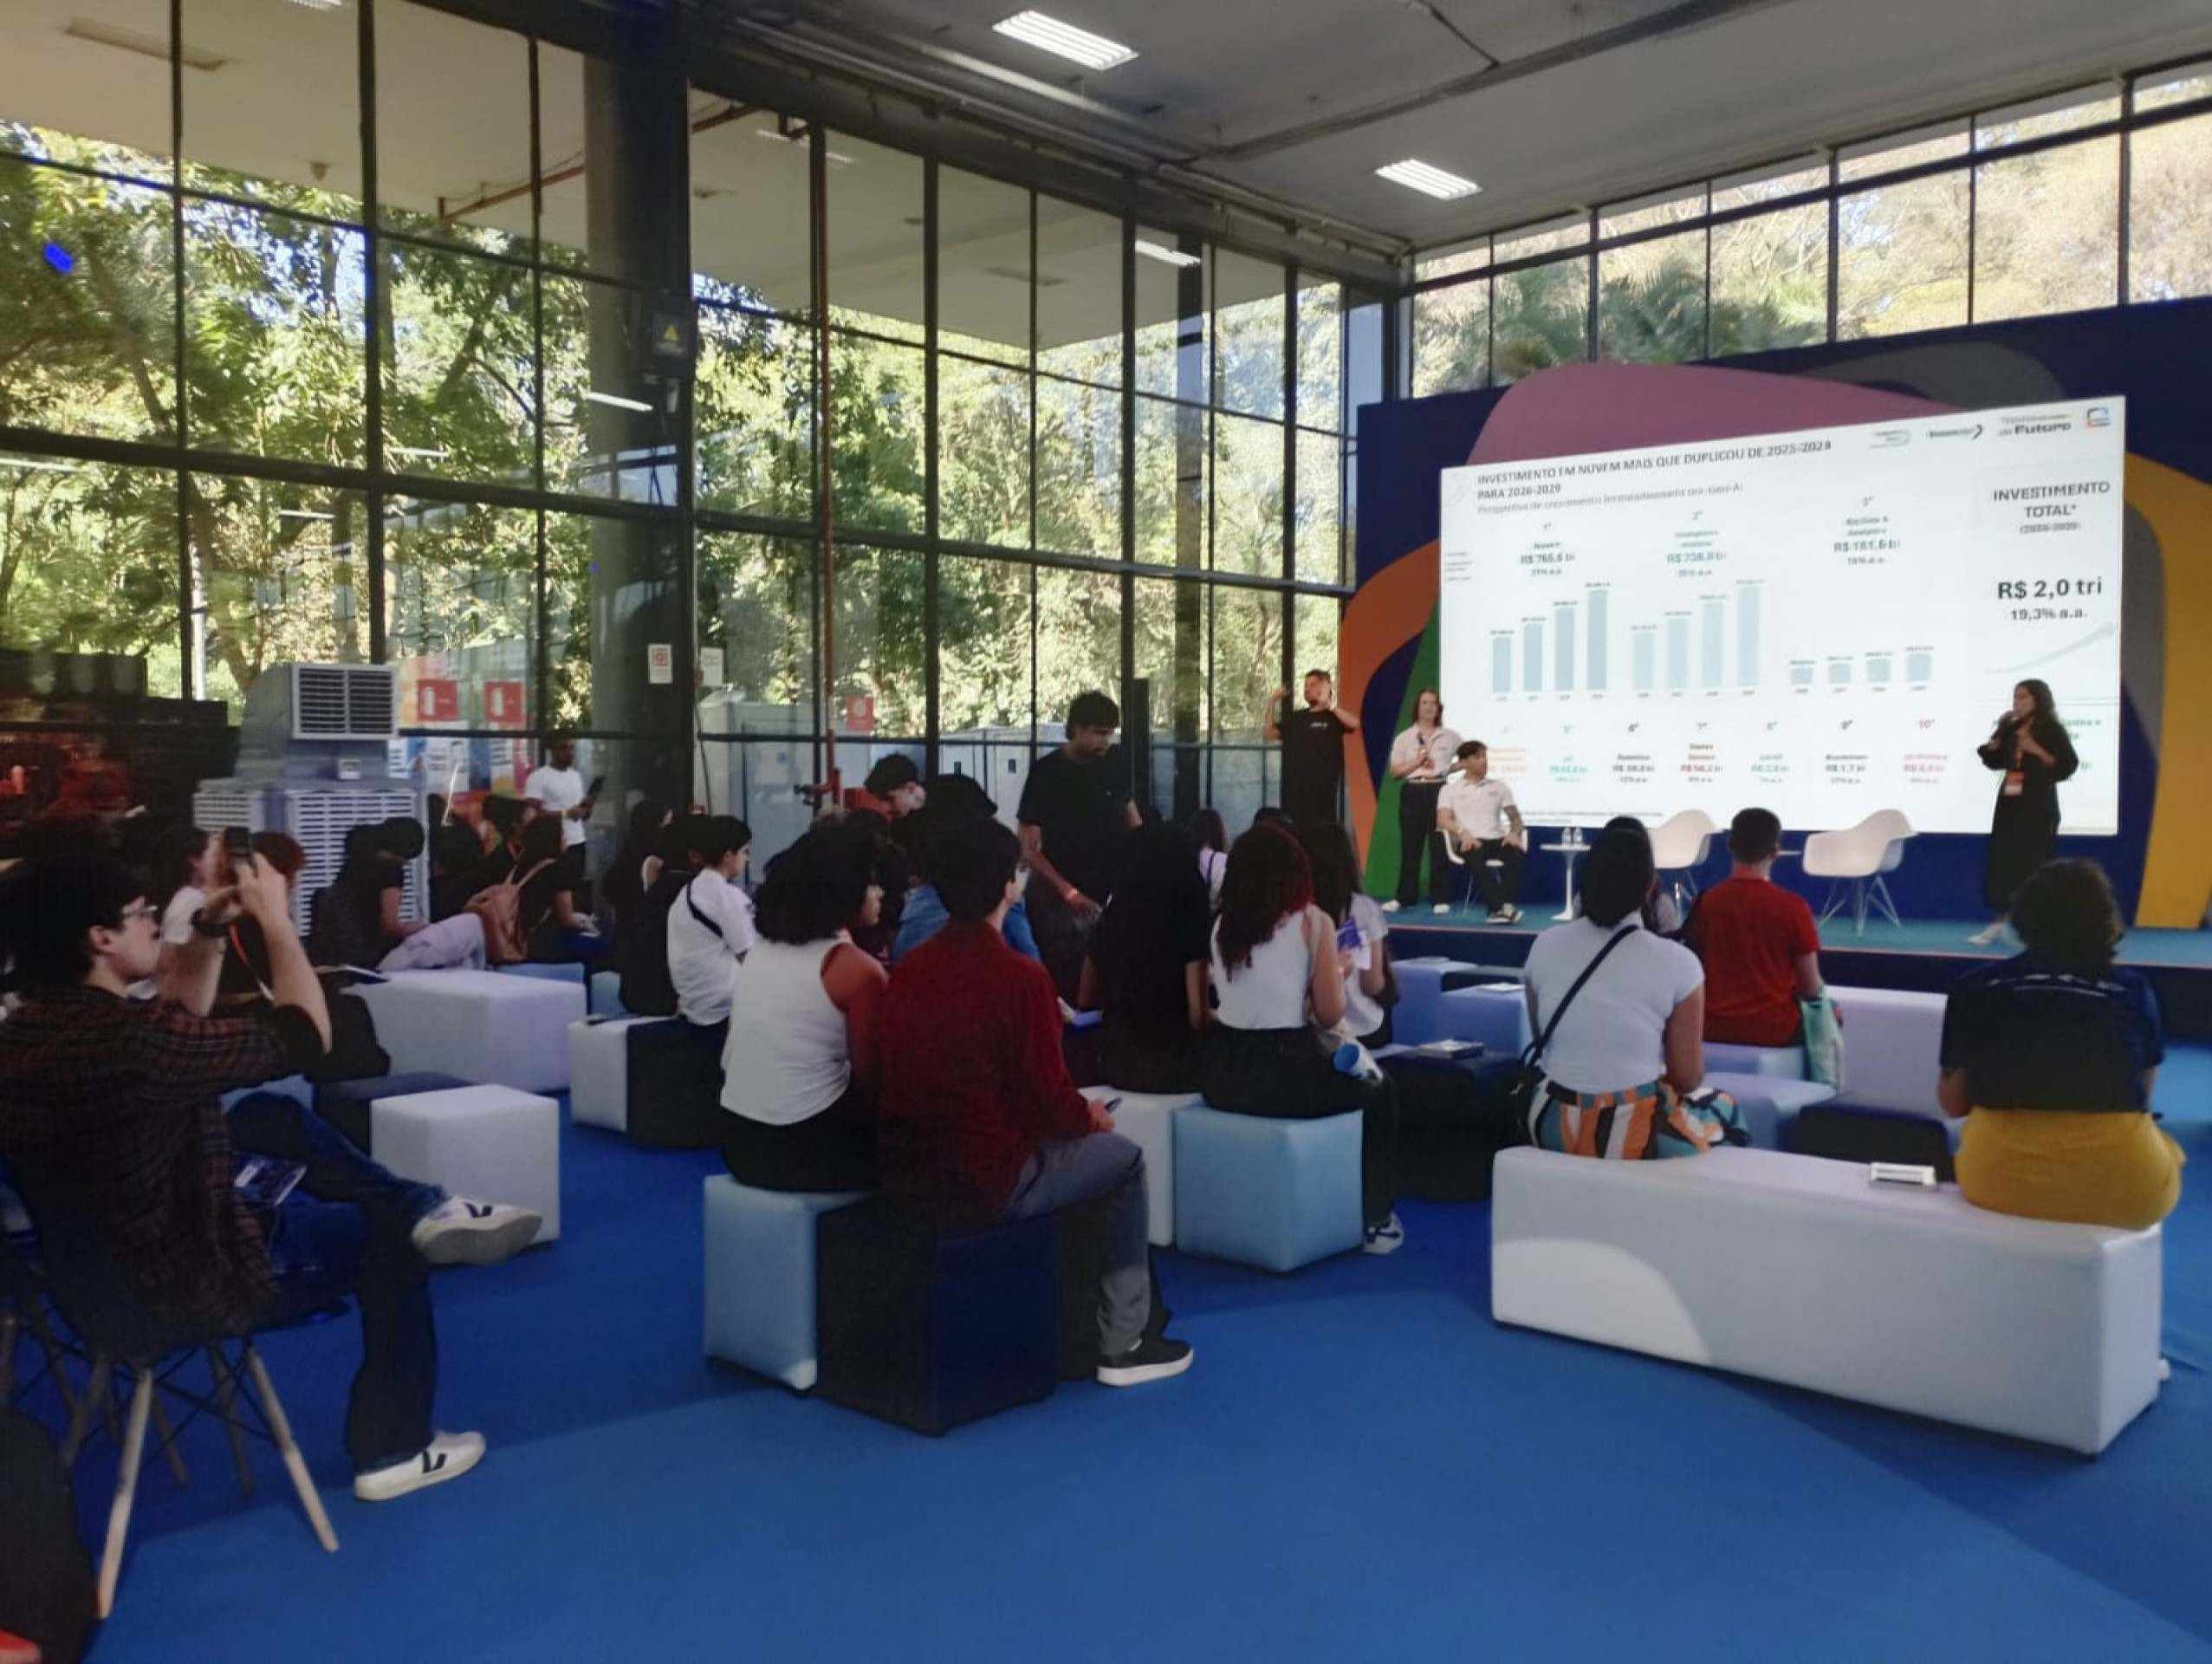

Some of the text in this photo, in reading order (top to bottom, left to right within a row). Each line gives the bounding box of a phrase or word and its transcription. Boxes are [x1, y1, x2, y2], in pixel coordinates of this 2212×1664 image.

[1477, 467, 1556, 485] INVESTIMENTO
[1558, 465, 1577, 478] EM
[1577, 461, 1621, 477] NUVEM
[1623, 457, 1654, 471] MAIS
[1655, 453, 1681, 469] QUE
[1683, 447, 1745, 466] DUPLICOU
[1747, 445, 1766, 459] DE
[1476, 486, 1506, 501] PARA
[1993, 481, 2111, 501] INVESTIMENTO
[1997, 575, 2102, 600] R$ 2,0 tri
